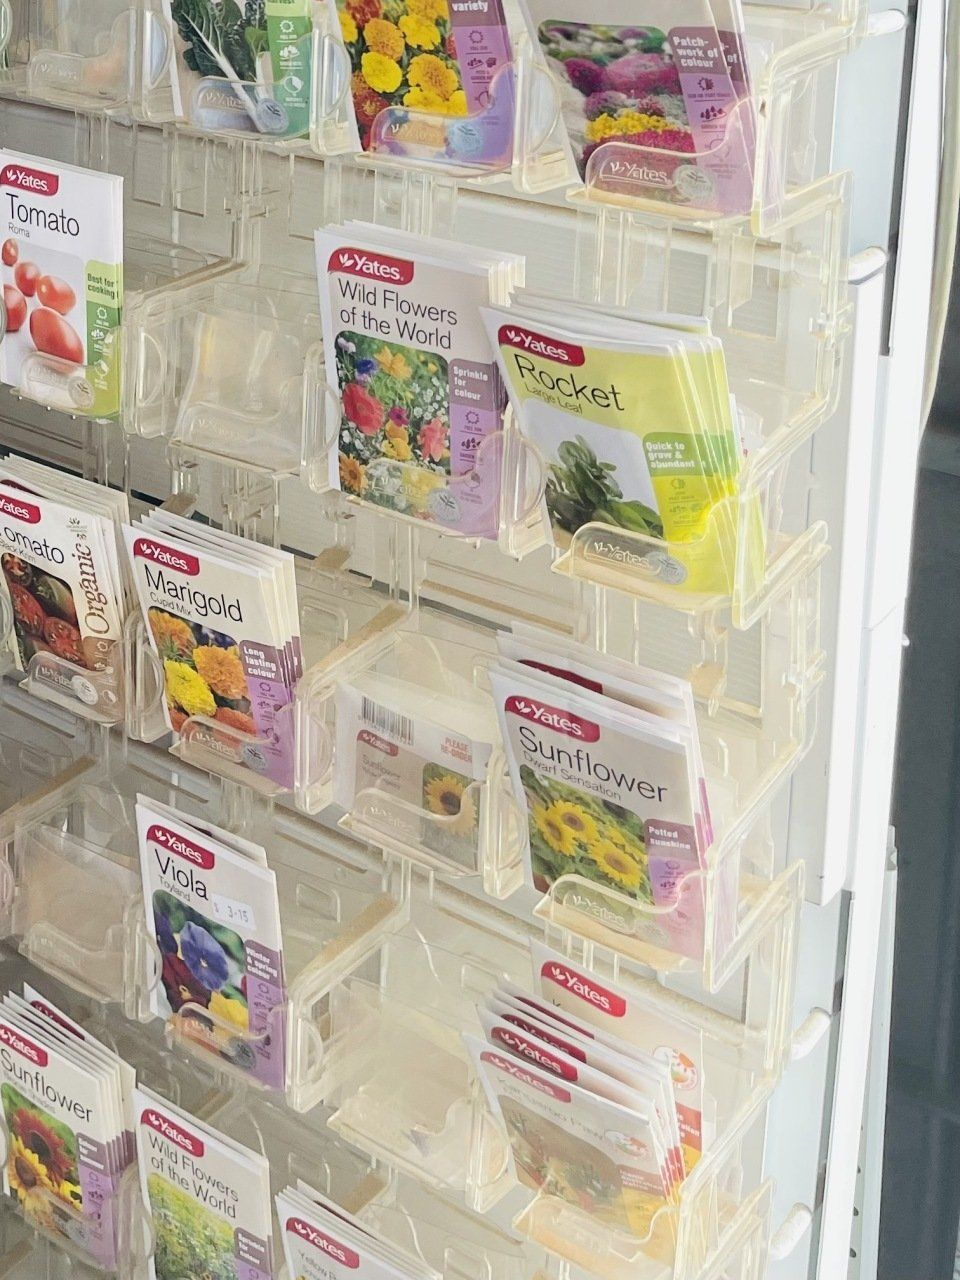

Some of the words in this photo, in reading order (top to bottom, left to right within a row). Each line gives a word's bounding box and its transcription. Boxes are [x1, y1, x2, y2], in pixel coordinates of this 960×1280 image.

[452, 0, 489, 13] variety
[5, 193, 80, 237] Tomato
[354, 257, 404, 281] Yates
[338, 279, 378, 307] Wild
[383, 289, 457, 326] Flowers
[341, 307, 357, 326] of
[362, 310, 391, 334] the
[395, 320, 452, 350] World
[514, 354, 625, 411] Rocket
[73, 543, 110, 636] Organic
[145, 565, 244, 623] Marigold
[532, 704, 584, 737] Yates
[520, 725, 667, 803] Sunflower
[154, 850, 208, 901] Viola
[1, 1048, 92, 1123] Sunflower
[158, 1118, 193, 1152] Yates
[148, 1130, 178, 1165] Wild
[181, 1155, 239, 1202] Flowers
[151, 1154, 165, 1173] of
[168, 1163, 190, 1192] the
[192, 1182, 237, 1219] World
